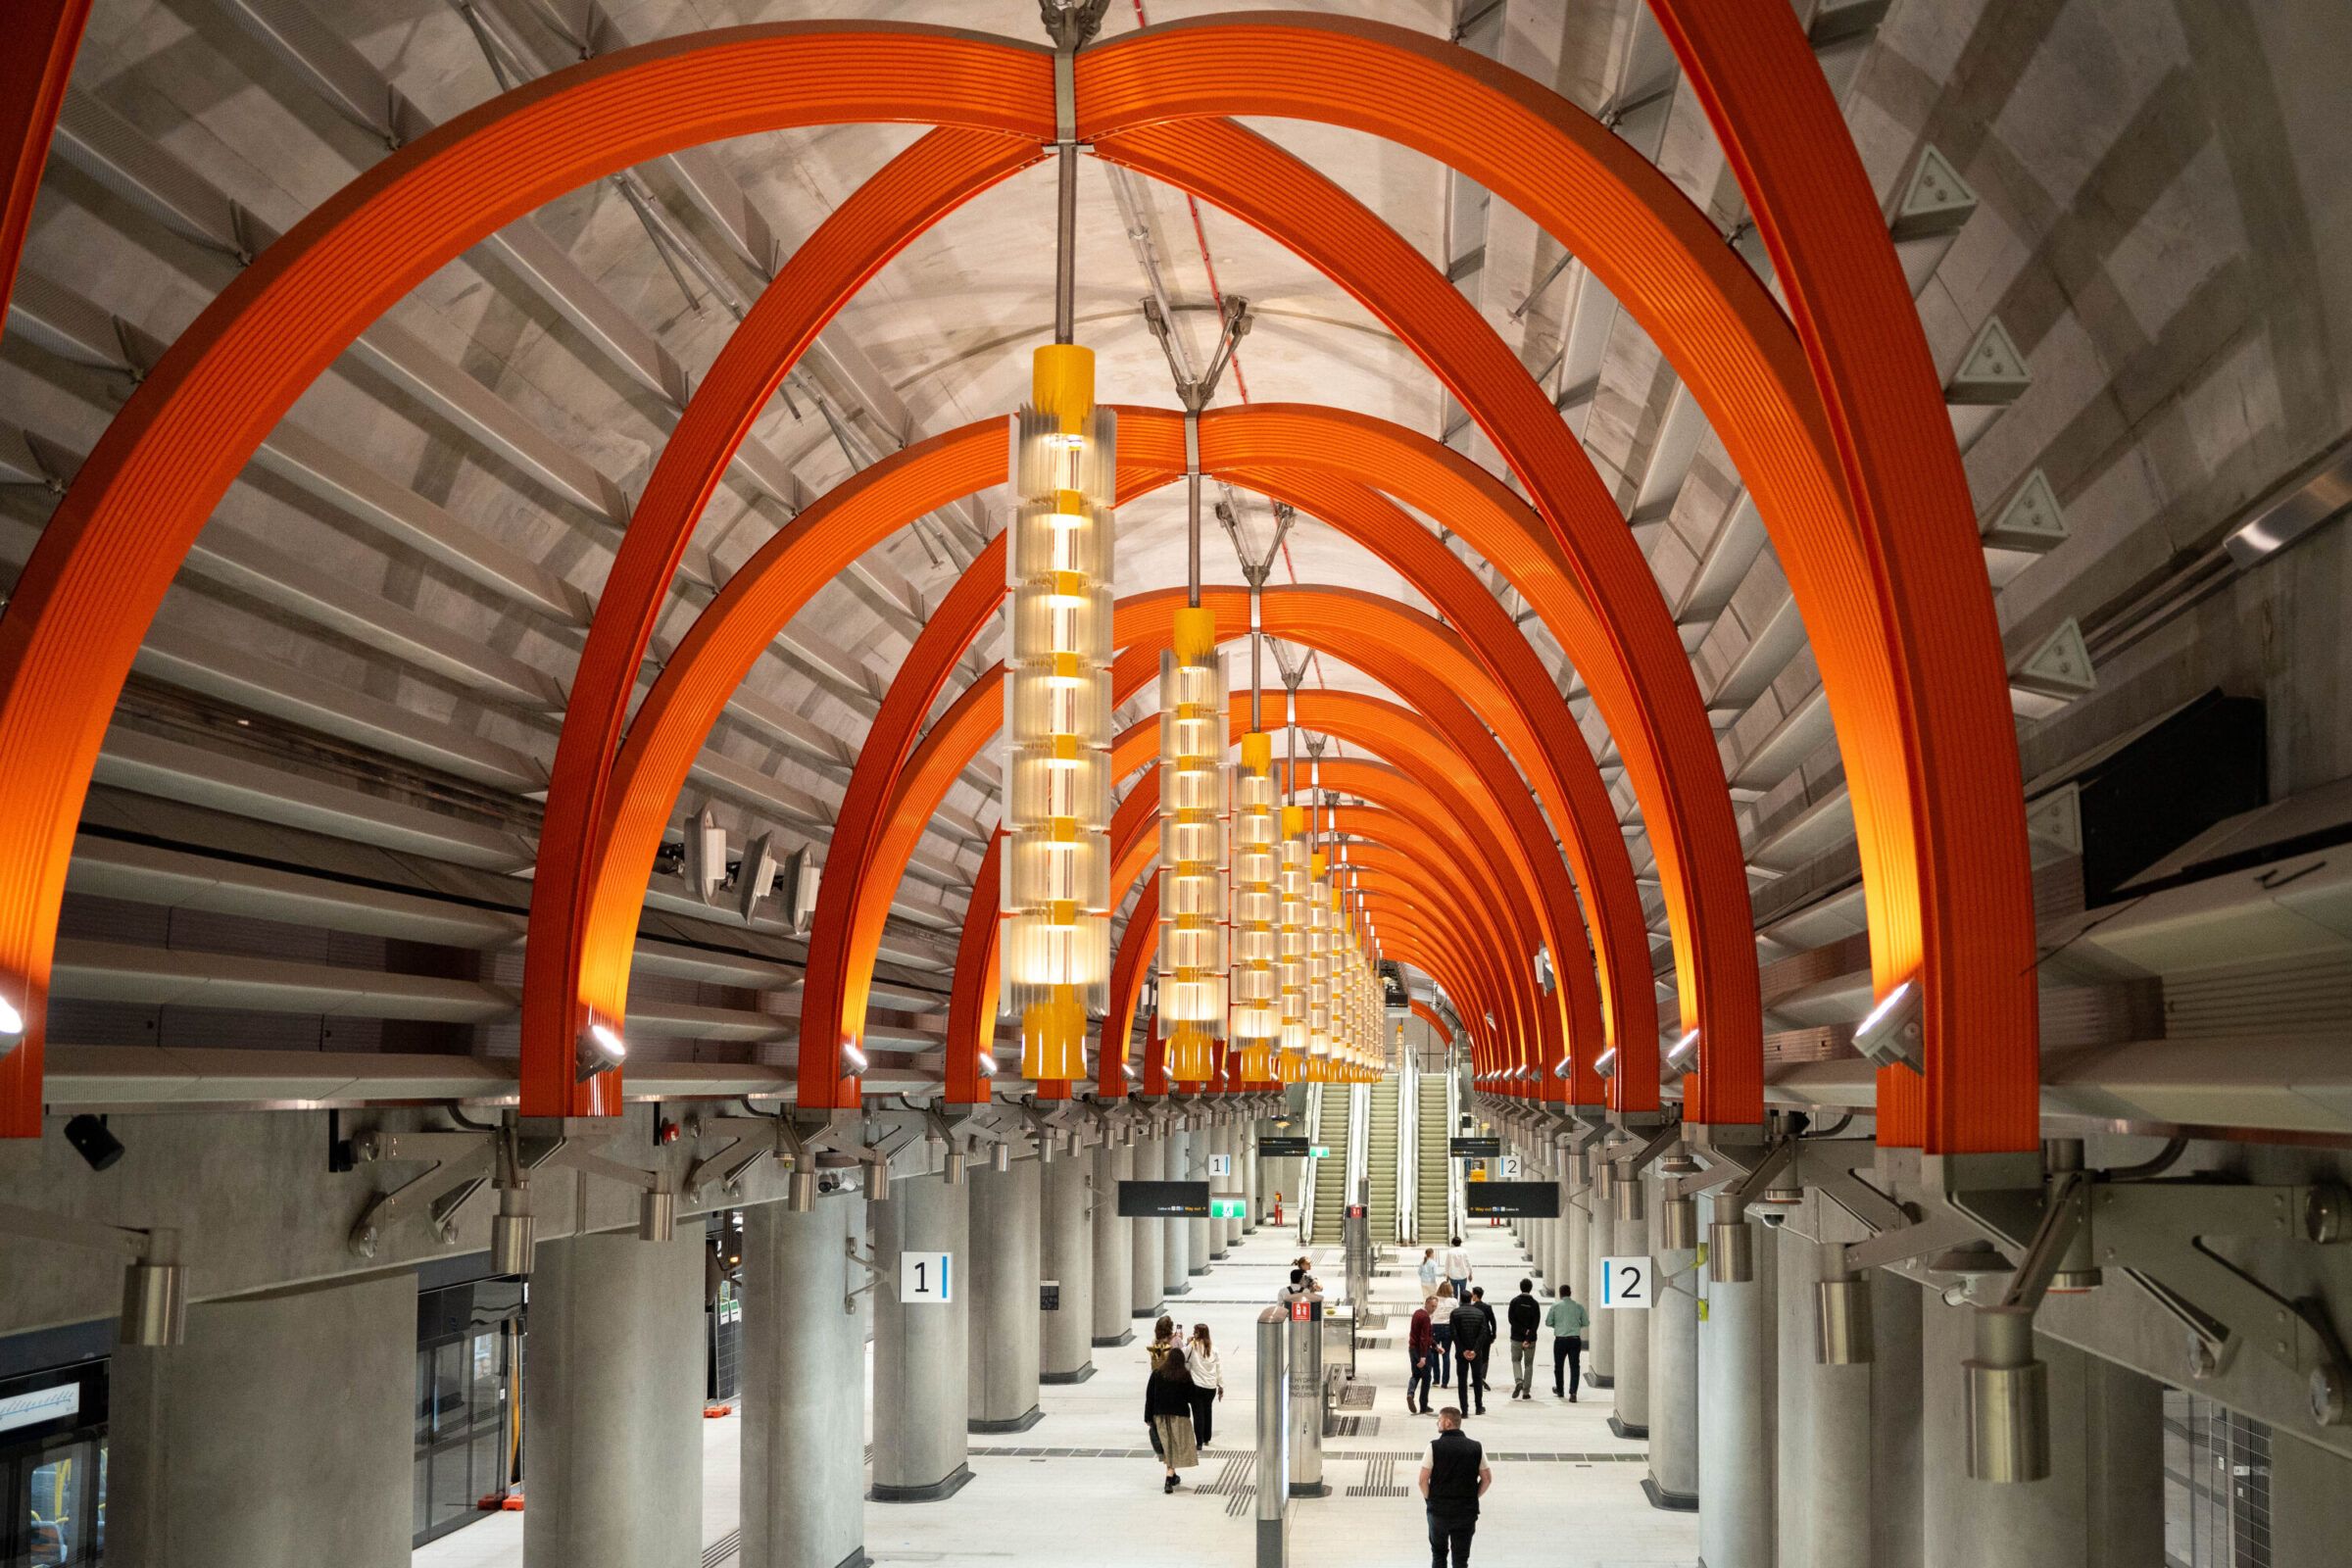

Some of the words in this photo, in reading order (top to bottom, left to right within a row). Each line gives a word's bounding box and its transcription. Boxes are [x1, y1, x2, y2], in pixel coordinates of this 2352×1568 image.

[1214, 1158, 1220, 1172] 1
[1508, 1159, 1517, 1173] 2
[914, 1262, 929, 1293] 1
[1620, 1266, 1642, 1298] 2
